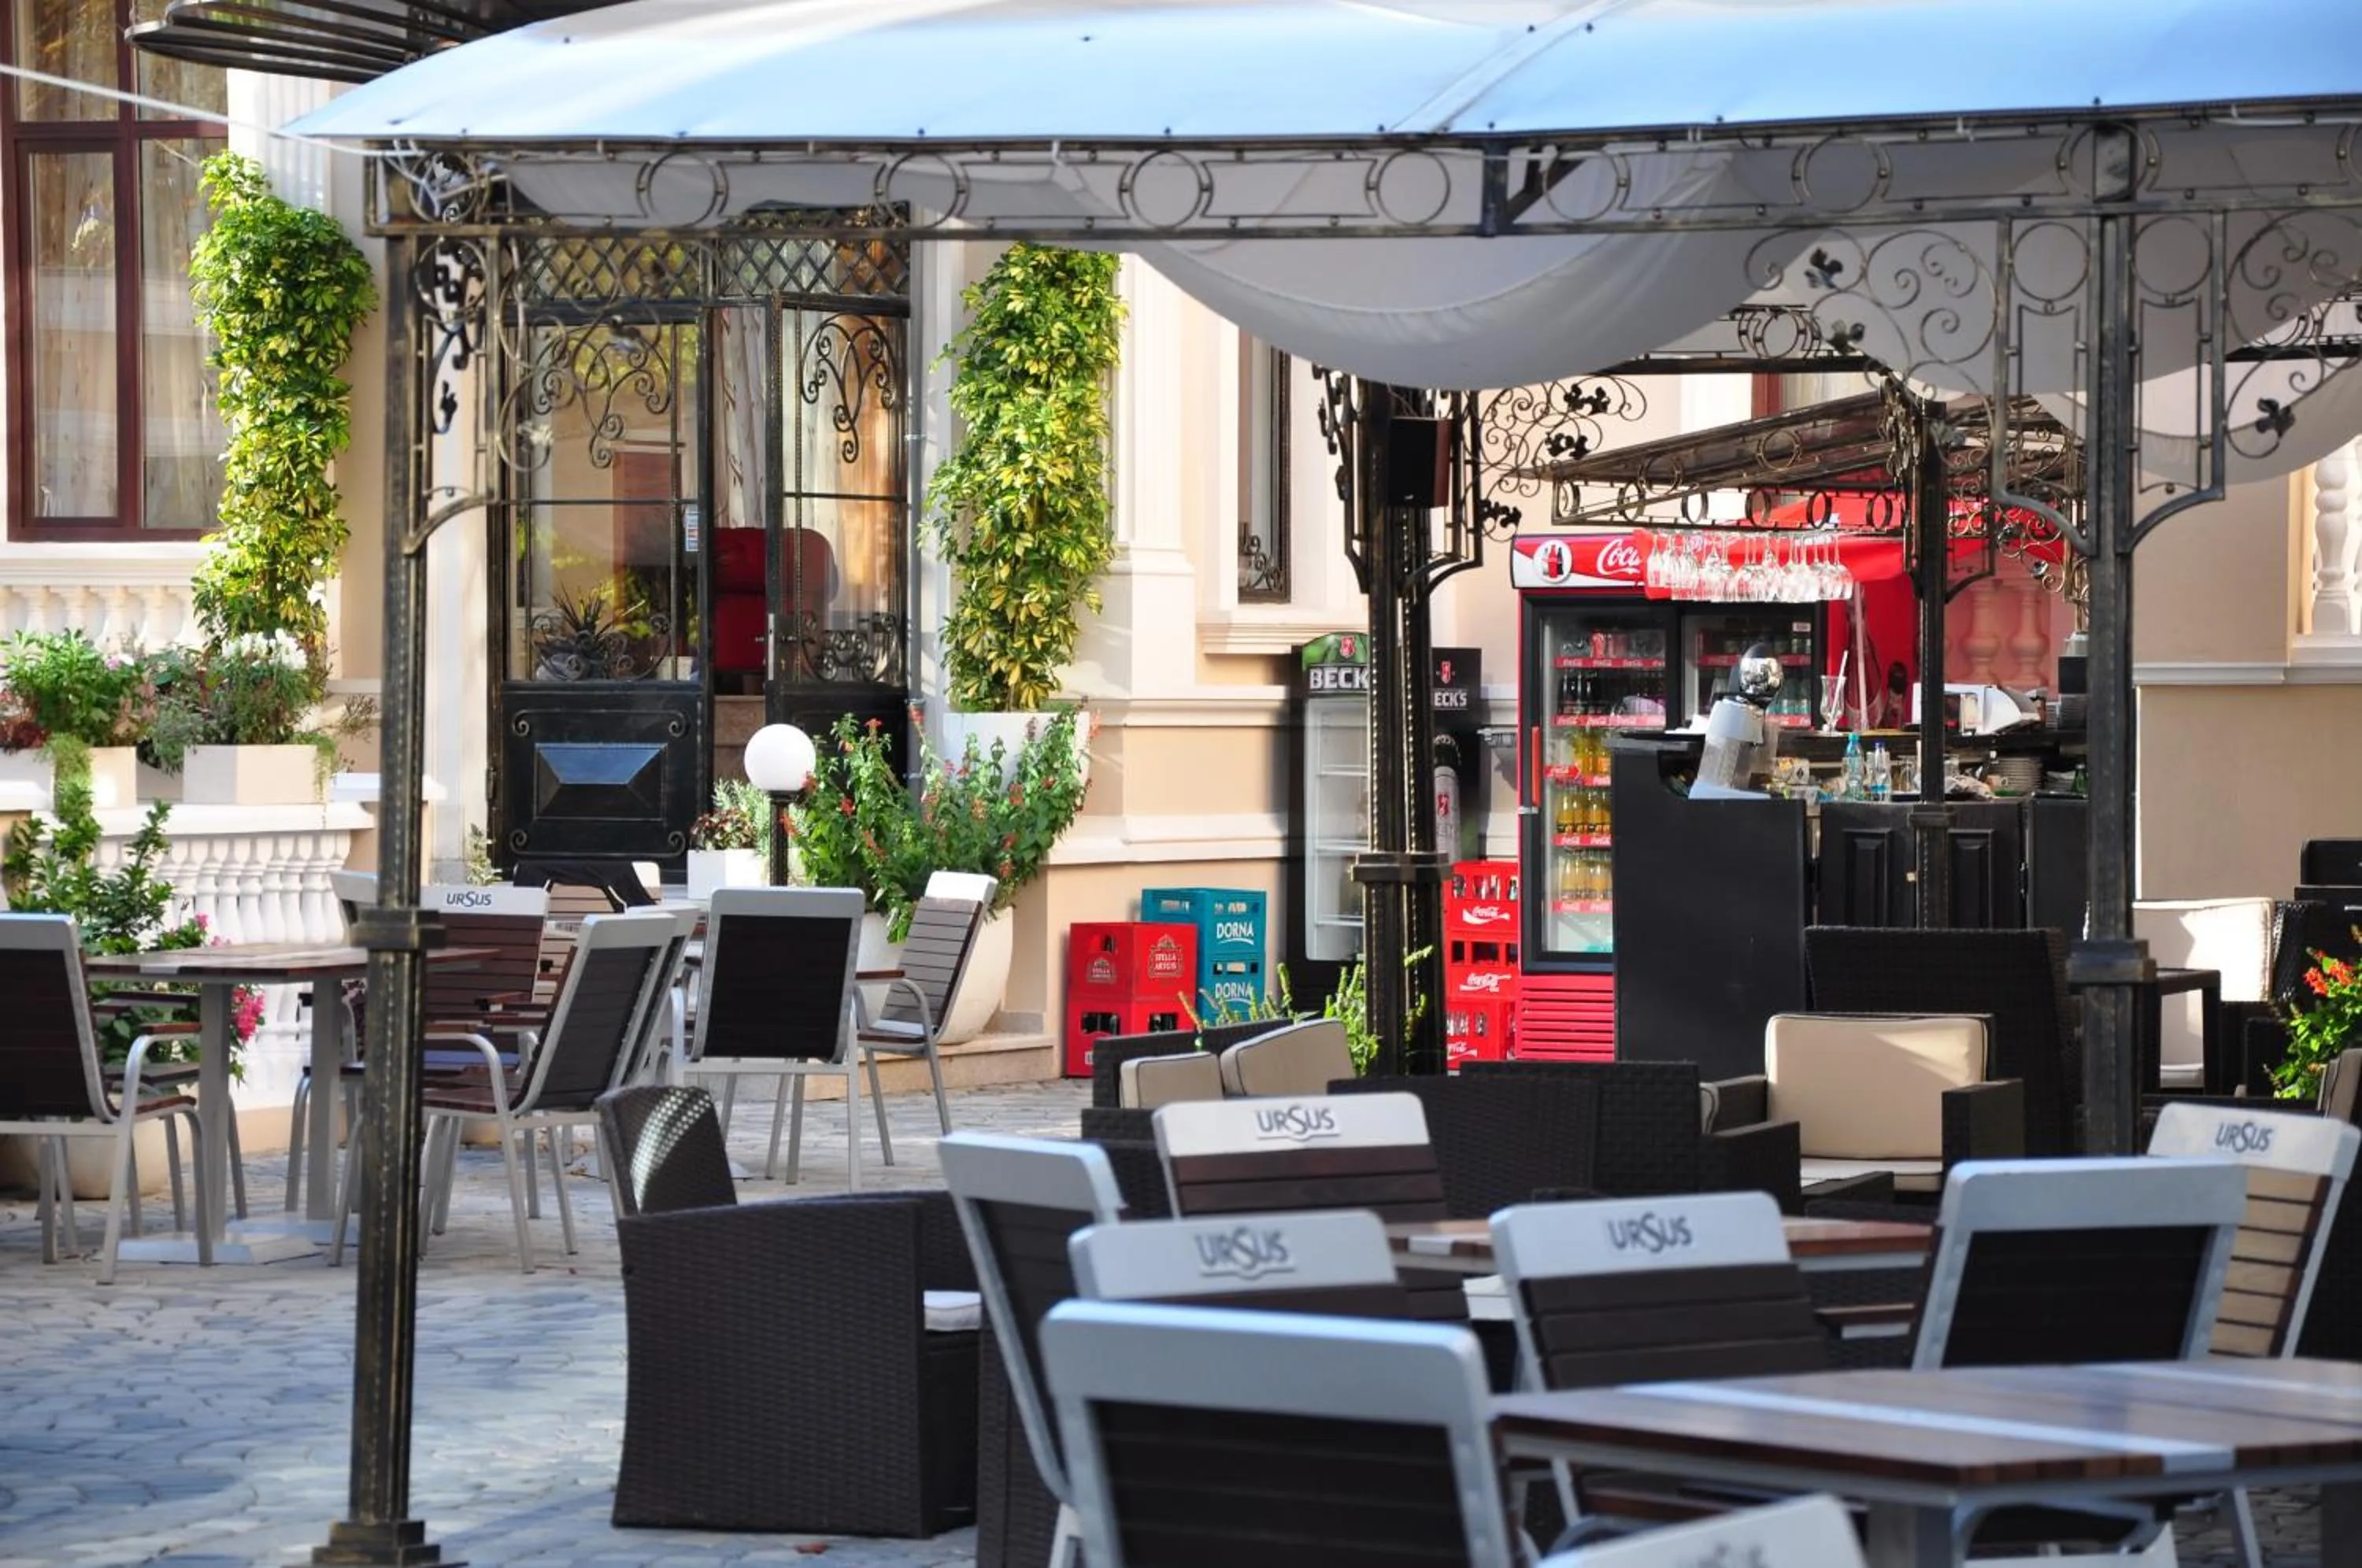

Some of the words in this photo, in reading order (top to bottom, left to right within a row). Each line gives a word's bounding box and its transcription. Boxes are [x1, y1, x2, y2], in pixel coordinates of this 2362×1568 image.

[1309, 667, 1369, 690] BECK
[1434, 690, 1468, 707] ECK'S
[446, 890, 492, 907] URSUS
[1216, 921, 1254, 939] DORNA
[1154, 952, 1177, 961] STELLA
[1215, 982, 1253, 999] DORNA
[1255, 1104, 1335, 1135] URSUS
[2214, 1122, 2275, 1153] URSUS
[1607, 1213, 1694, 1253] URSUS
[1195, 1226, 1289, 1268] URSUS
